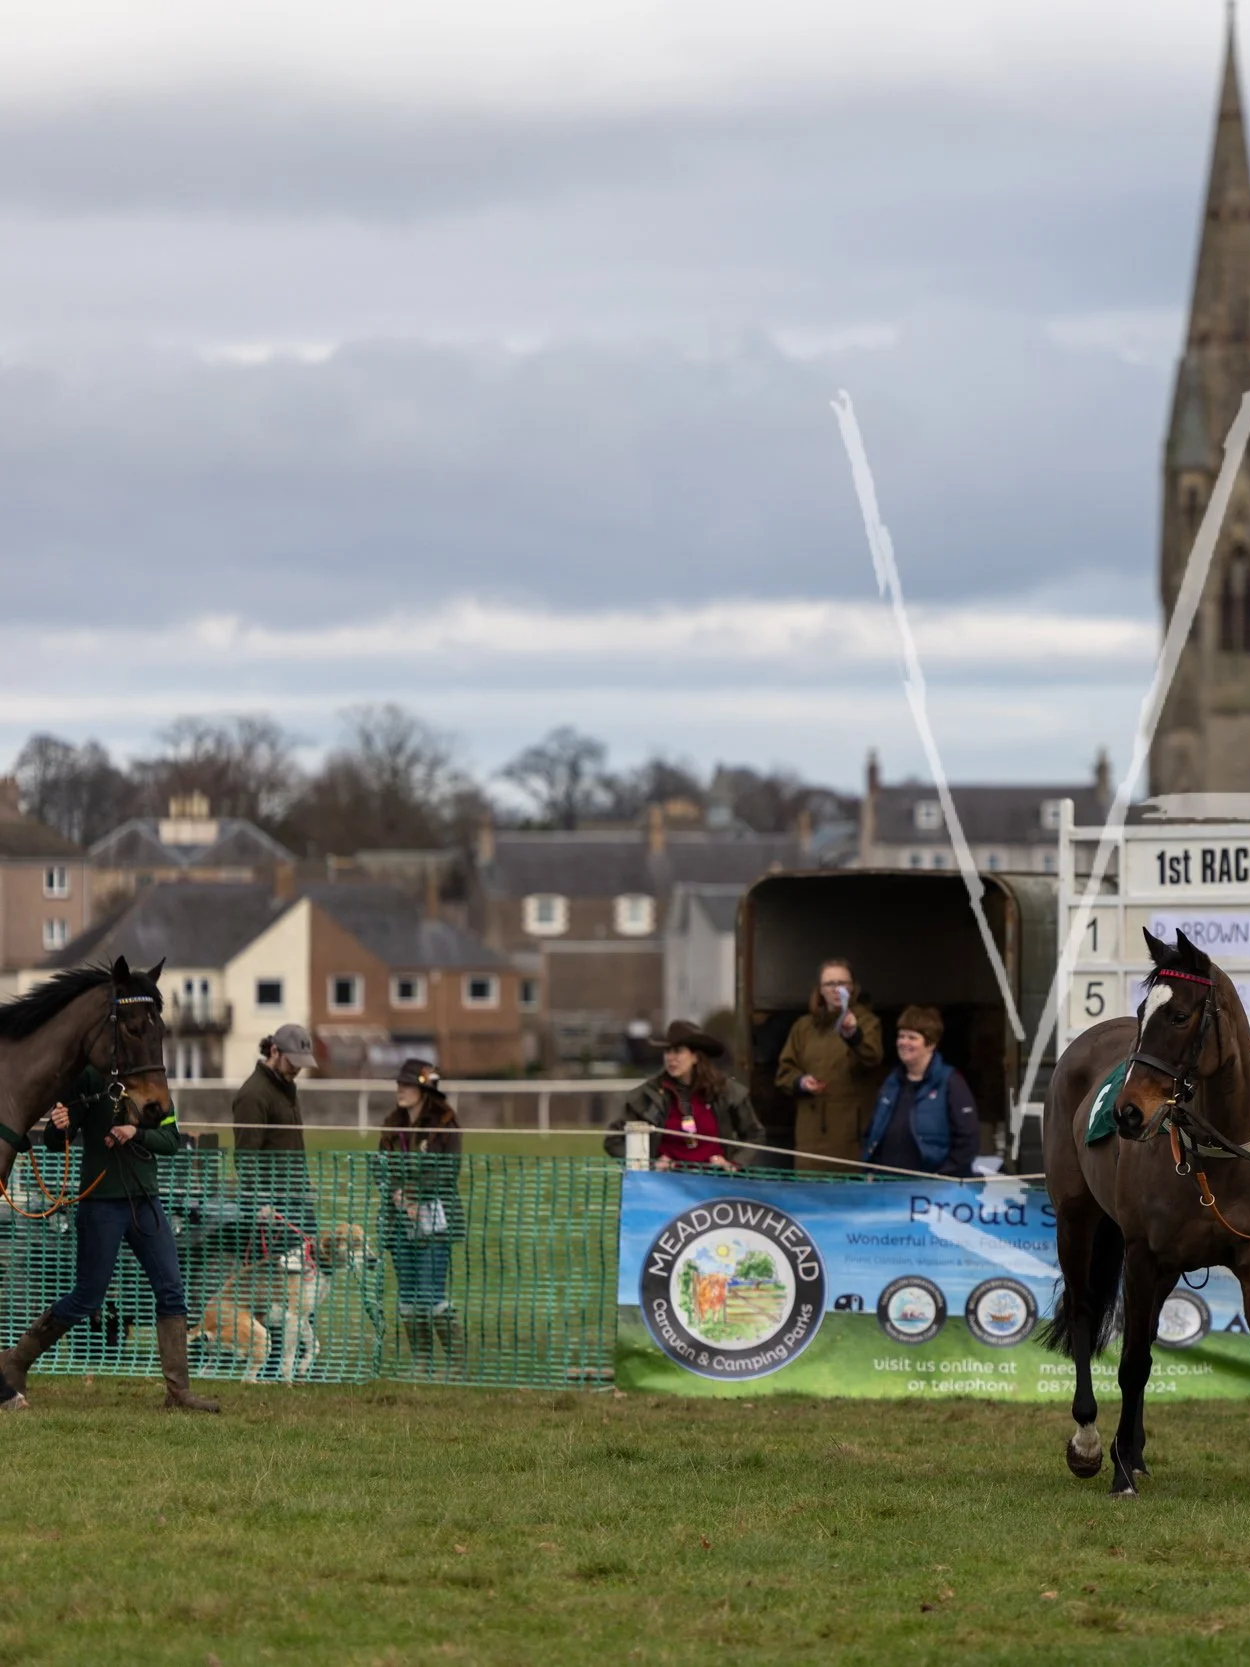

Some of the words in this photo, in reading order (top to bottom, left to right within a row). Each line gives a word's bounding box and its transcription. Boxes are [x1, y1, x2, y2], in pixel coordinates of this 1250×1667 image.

[1157, 849, 1192, 885] 1st
[1086, 917, 1098, 952] 1
[1181, 918, 1250, 945] BROWN
[1085, 981, 1106, 1017] 5
[910, 1195, 1028, 1227] Proud
[649, 1203, 819, 1282] MEADOWHEAD
[846, 1233, 925, 1247] Wonderful
[652, 1298, 696, 1361] Caravan
[697, 1351, 710, 1367] &
[712, 1343, 788, 1371] Camping
[783, 1303, 813, 1348] Parks
[873, 1357, 912, 1371] visit
[916, 1359, 936, 1372] us
[940, 1359, 994, 1374] online
[998, 1361, 1017, 1374] at
[907, 1379, 927, 1391] or
